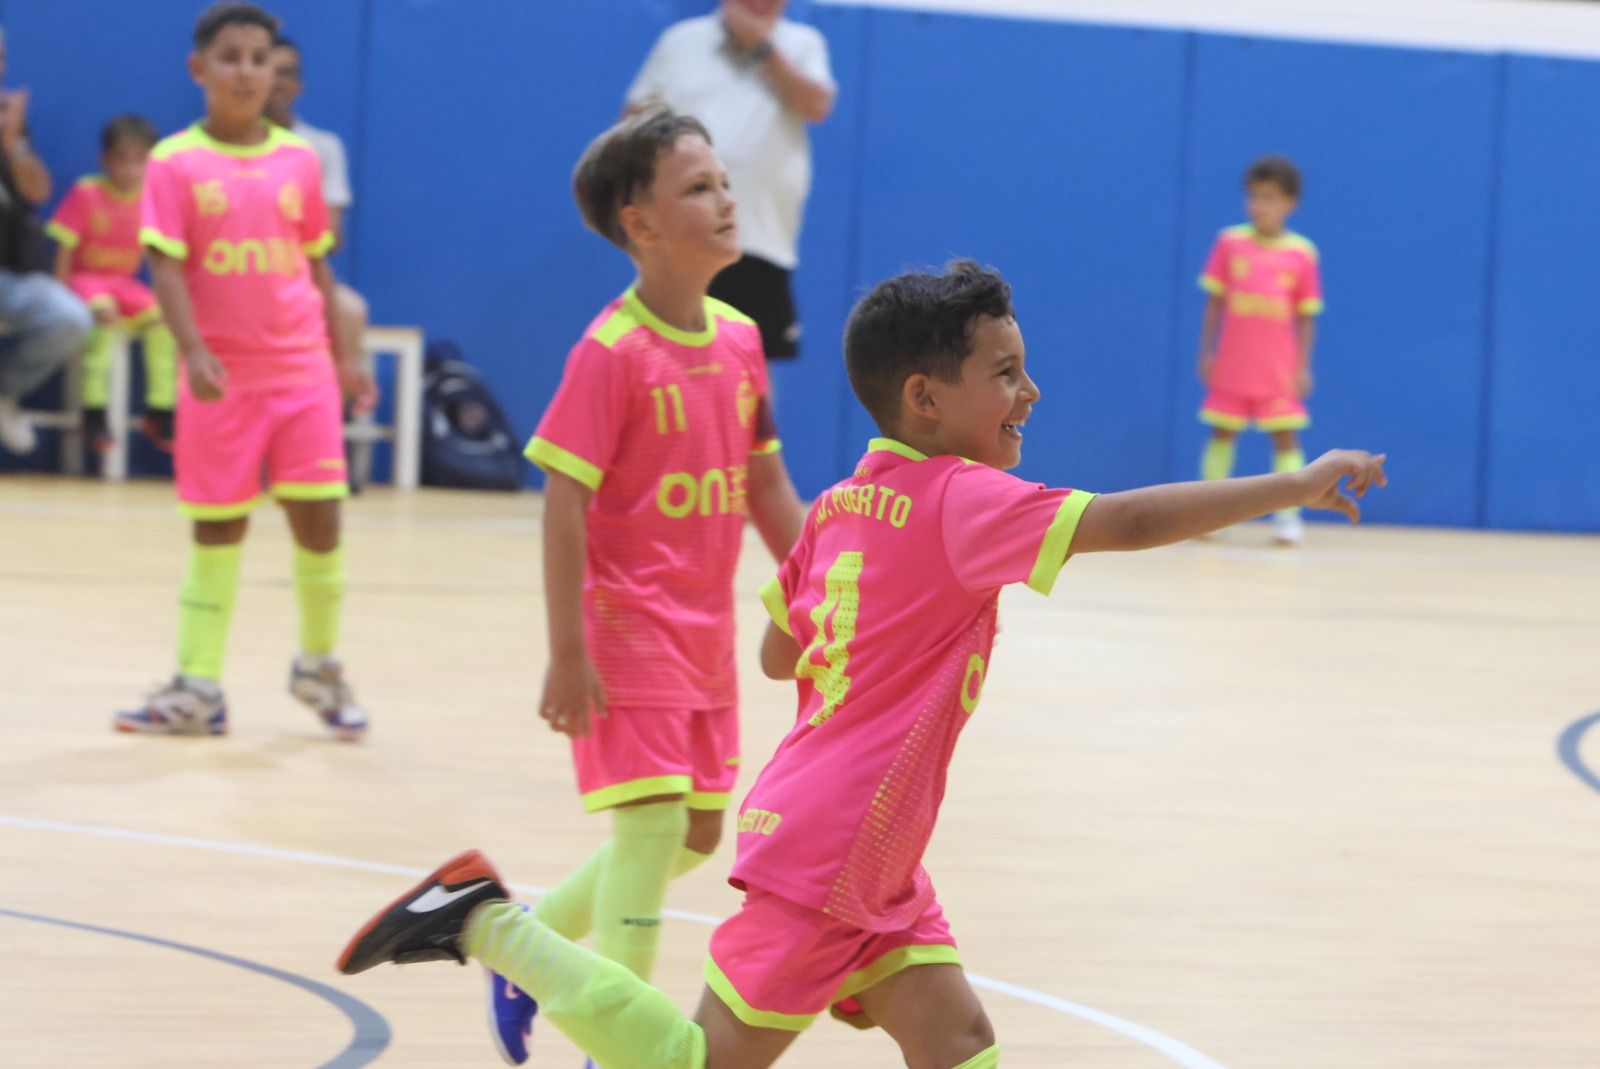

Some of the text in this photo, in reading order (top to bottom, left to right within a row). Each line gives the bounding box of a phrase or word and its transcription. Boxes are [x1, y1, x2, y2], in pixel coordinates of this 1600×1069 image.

[193, 180, 228, 216] 15
[652, 384, 687, 435] 11
[832, 484, 912, 528] PUERTO
[795, 551, 864, 727] 4
